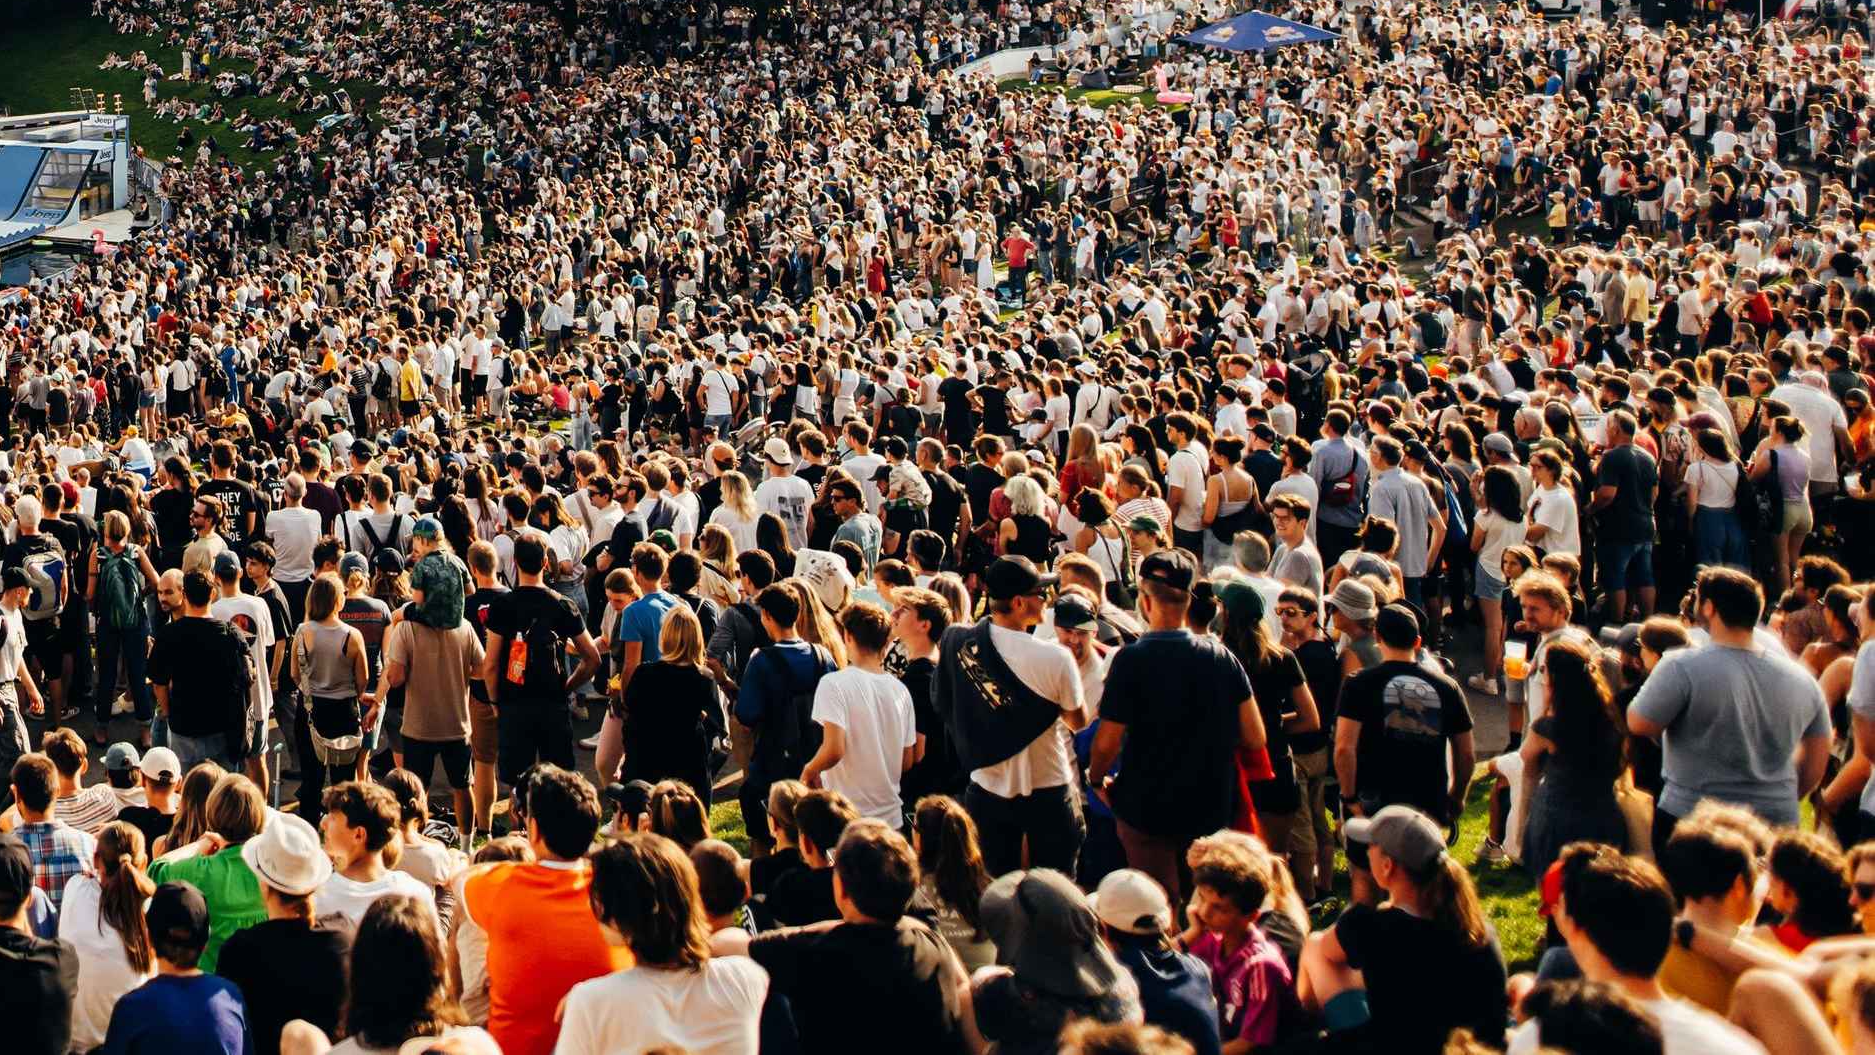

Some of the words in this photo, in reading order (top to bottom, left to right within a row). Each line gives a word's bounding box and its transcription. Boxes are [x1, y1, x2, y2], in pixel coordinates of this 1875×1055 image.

[94, 116, 113, 125] Jeep
[99, 150, 111, 161] Jeep
[25, 209, 61, 220] Jeep
